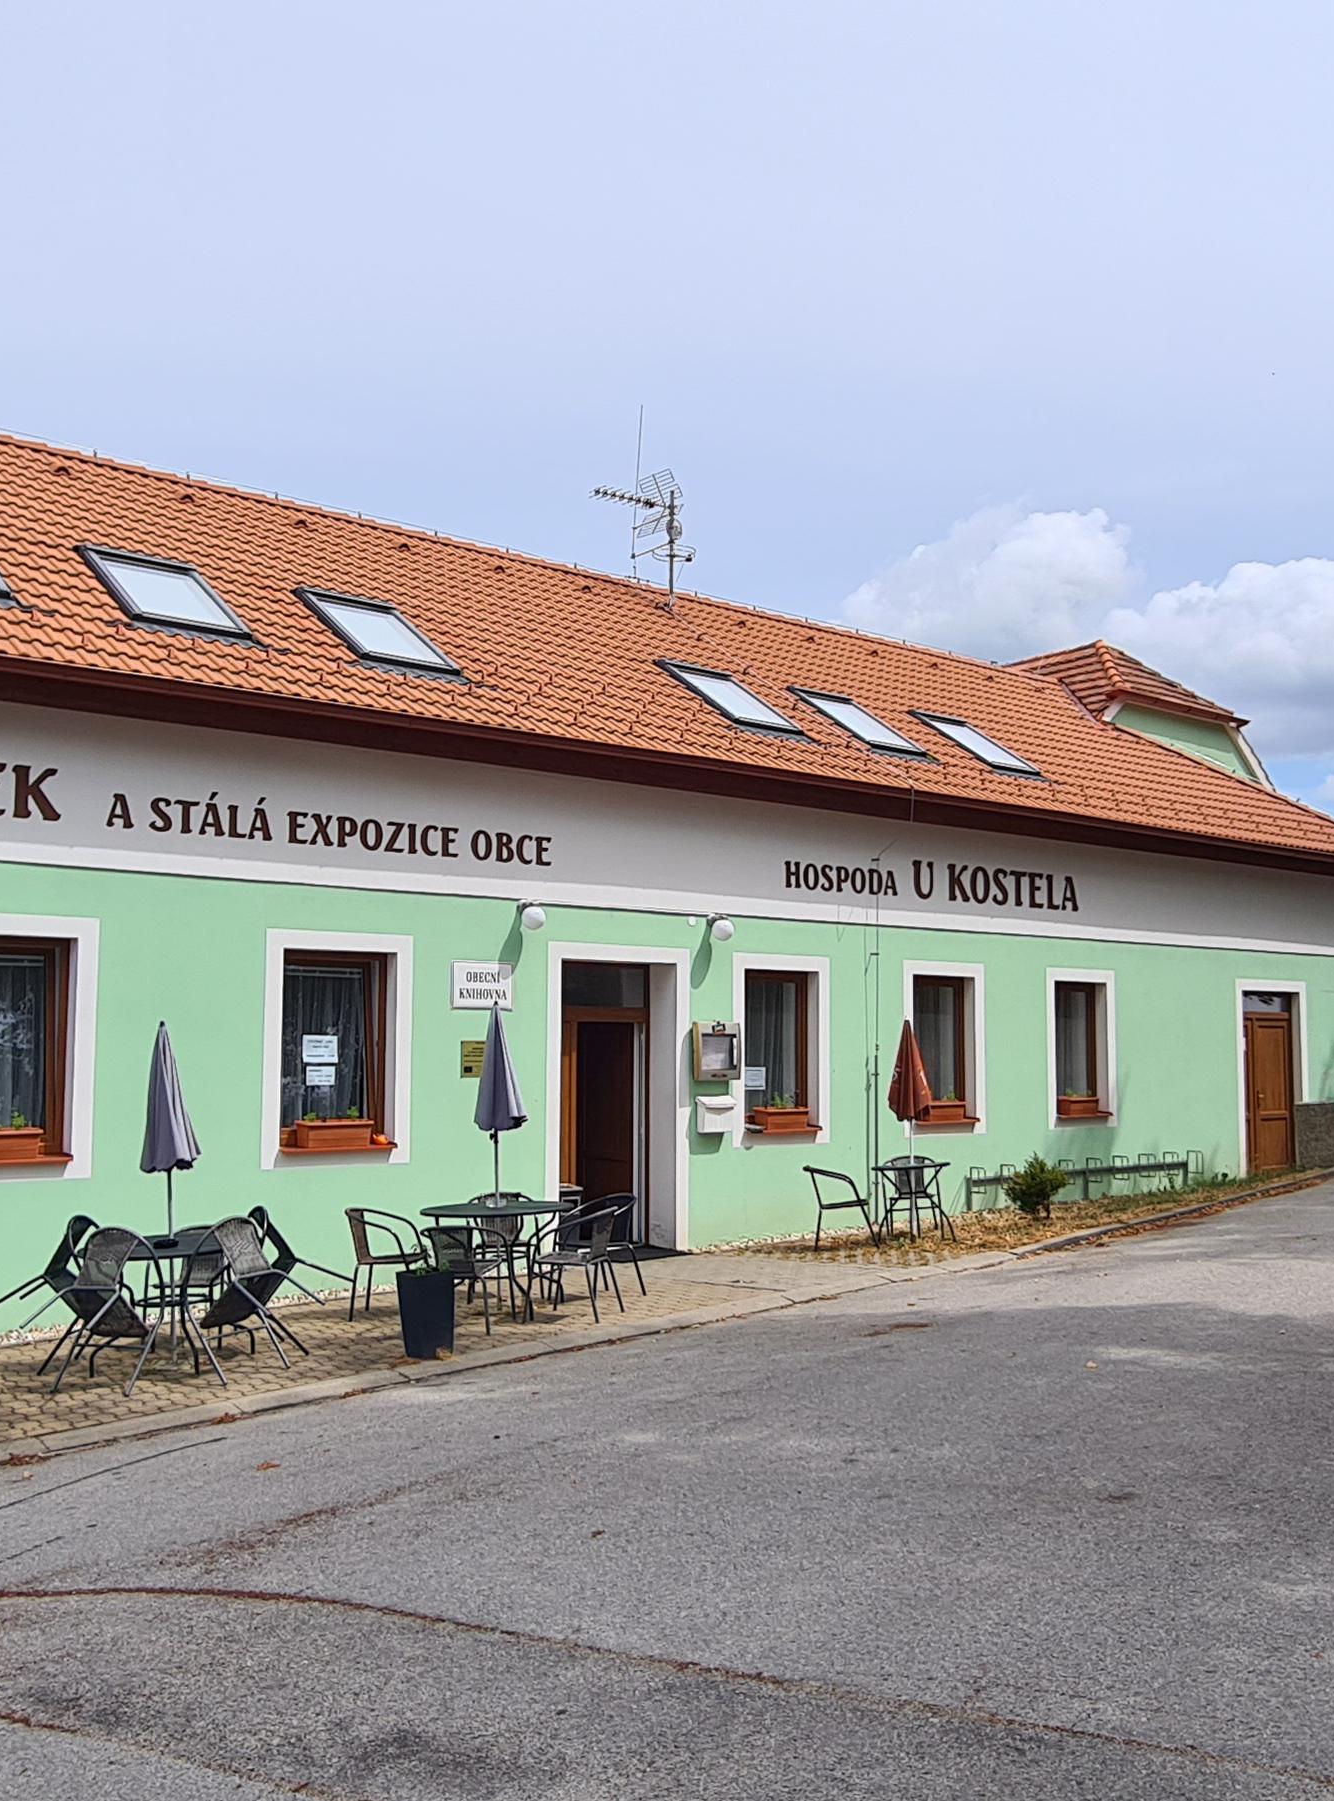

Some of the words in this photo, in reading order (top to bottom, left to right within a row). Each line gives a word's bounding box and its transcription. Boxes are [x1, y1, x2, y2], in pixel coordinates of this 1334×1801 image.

[106, 793, 134, 830] A
[149, 791, 273, 842] STÁLÁ
[287, 811, 459, 858] EXPOZICE
[470, 830, 552, 867] OBCE
[784, 859, 898, 897] HOSPODA
[912, 860, 934, 900] U
[947, 863, 1079, 912] KOSTELA
[466, 970, 501, 984] OBECNÍ
[459, 987, 507, 1001] KNIHOVNA
